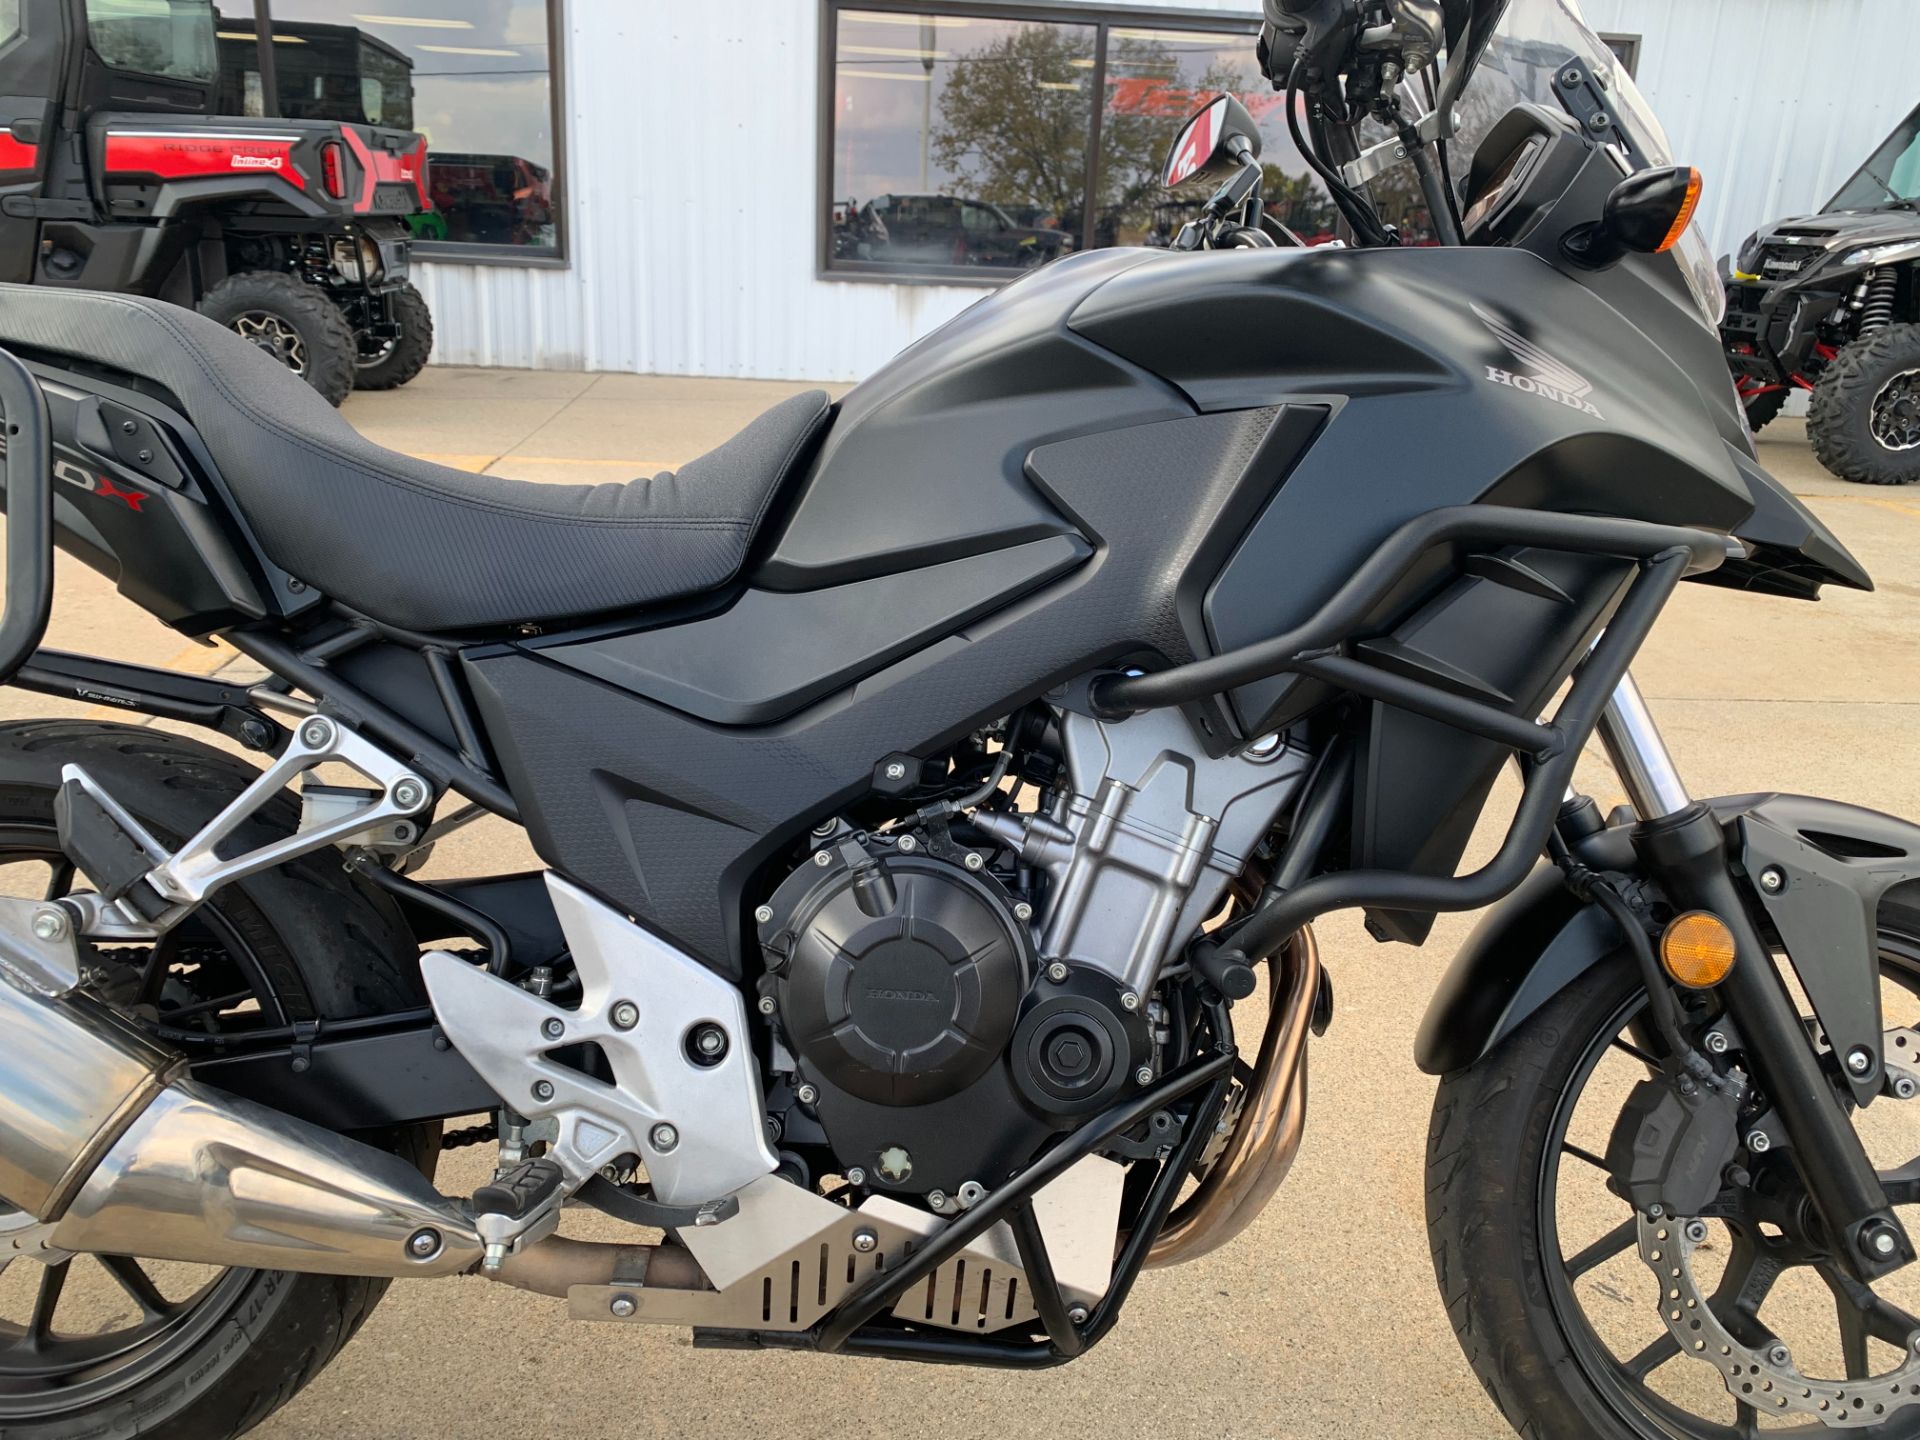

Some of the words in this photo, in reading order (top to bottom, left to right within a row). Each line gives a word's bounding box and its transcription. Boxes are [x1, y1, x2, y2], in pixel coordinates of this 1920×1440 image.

[163, 143, 224, 153] RIDGE
[229, 145, 280, 155] CREW
[1485, 365, 1606, 422] HONDA
[866, 987, 940, 1002] HONDA
